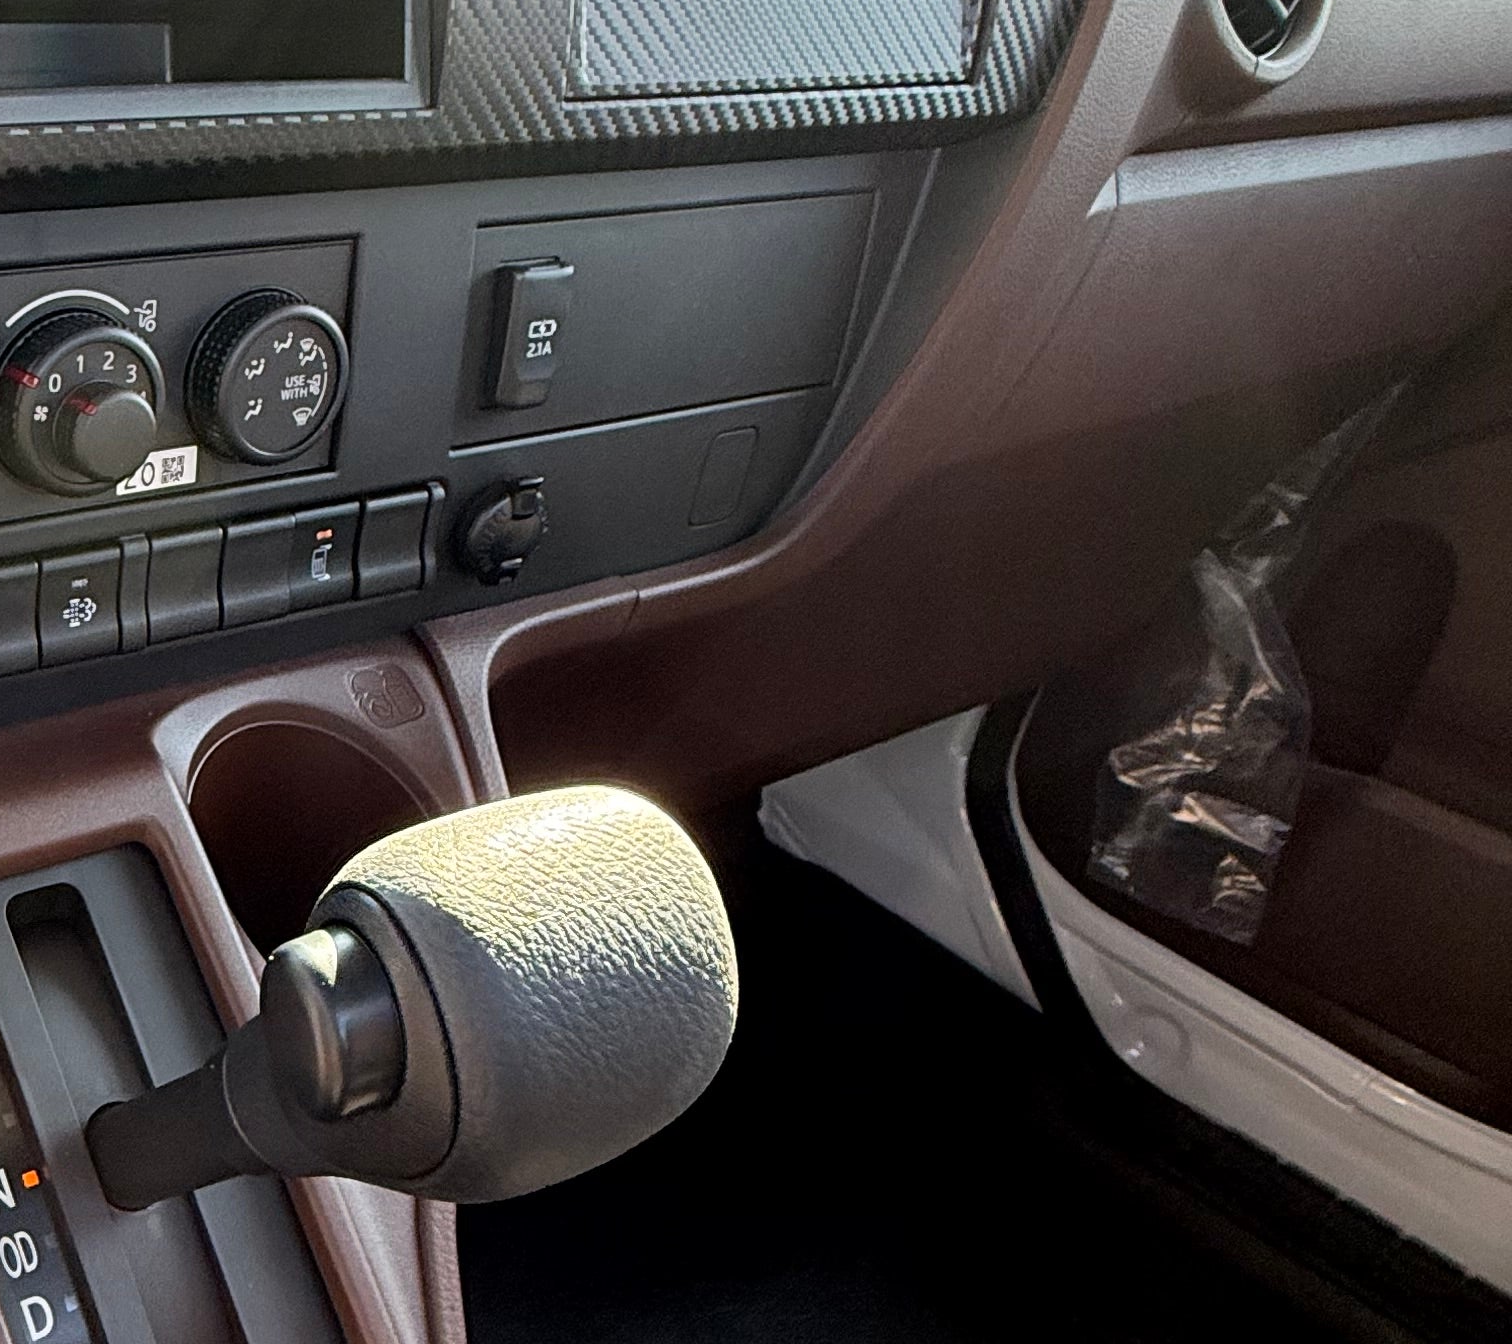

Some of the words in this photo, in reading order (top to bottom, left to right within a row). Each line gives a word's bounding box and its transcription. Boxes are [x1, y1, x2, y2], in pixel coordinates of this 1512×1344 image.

[76, 354, 84, 373] 1
[102, 351, 115, 371] 2
[125, 364, 137, 383] 3
[285, 375, 306, 388] USE
[48, 374, 62, 393] 0
[281, 387, 308, 401] WITH
[20, 1295, 54, 1341] D
